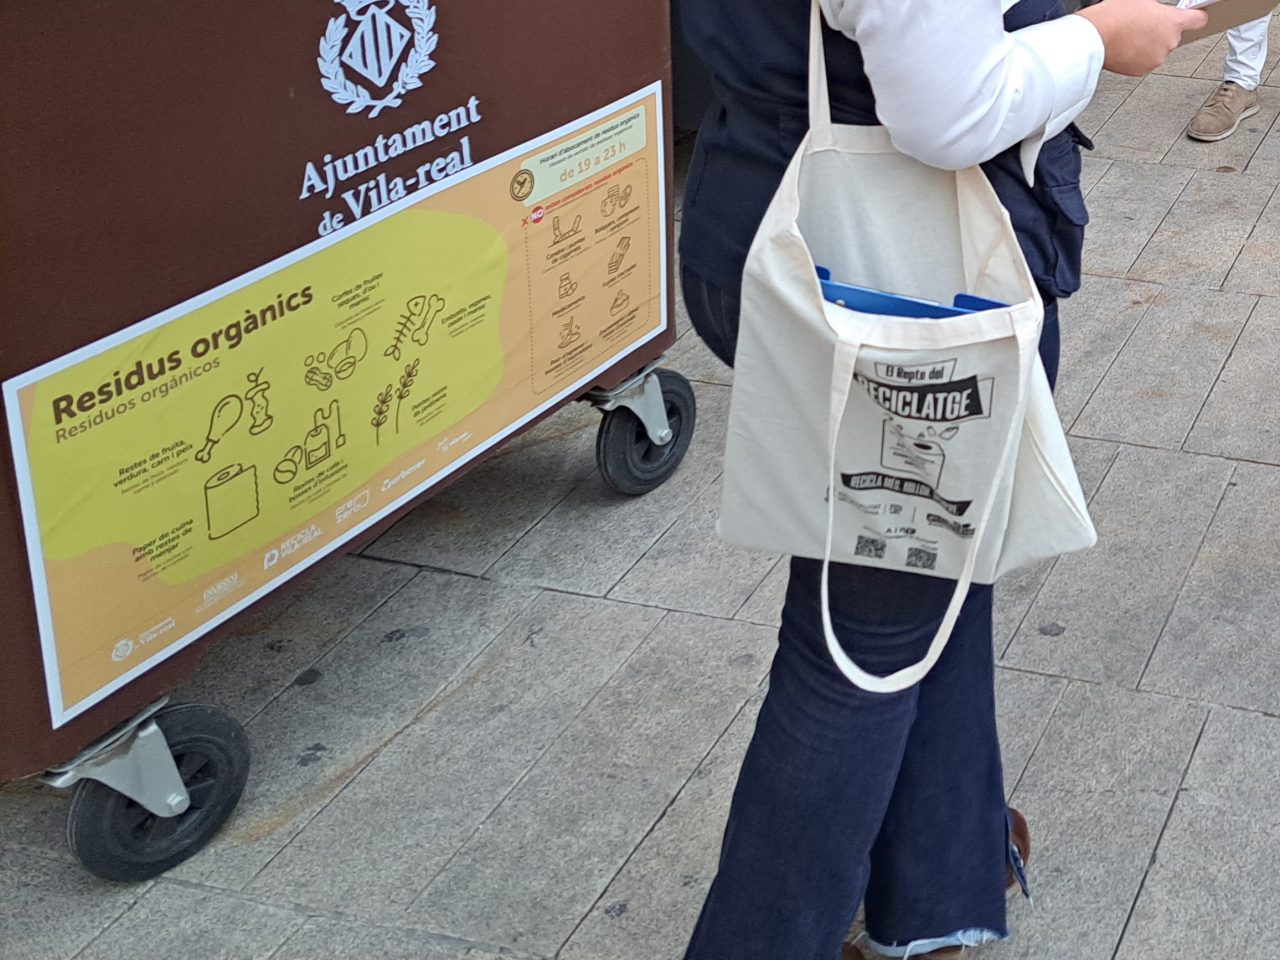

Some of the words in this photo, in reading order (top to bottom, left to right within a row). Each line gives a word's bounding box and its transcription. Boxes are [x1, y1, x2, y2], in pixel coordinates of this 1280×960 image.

[300, 96, 481, 200] Ajuntament
[560, 169, 575, 182] de
[578, 158, 591, 174] 19
[594, 156, 600, 166] a
[603, 145, 616, 161] 23
[619, 142, 626, 153] h
[318, 211, 345, 236] de
[341, 136, 473, 220] Vila-real
[531, 208, 544, 220] NO
[52, 349, 183, 425] Residus
[190, 285, 314, 359] orgànics
[886, 365, 895, 377] El
[897, 367, 926, 383] Repte
[928, 366, 944, 379] del
[55, 398, 136, 444] Residuos
[140, 356, 221, 403] orgánicos
[113, 467, 149, 487] verdura,
[151, 456, 170, 468] carn
[176, 444, 193, 458] peix
[119, 459, 147, 476] Restes
[149, 452, 160, 461] de
[161, 440, 186, 455] fruita,
[850, 474, 882, 489] RECICLA
[132, 539, 156, 557] Paper
[159, 532, 169, 541] de
[171, 519, 193, 534] cuina
[135, 549, 153, 563] amb
[156, 534, 180, 551] restes
[182, 527, 192, 536] de
[150, 542, 179, 562] menjar
[281, 524, 315, 550] RECICLA
[281, 528, 322, 557] VILA-REAL
